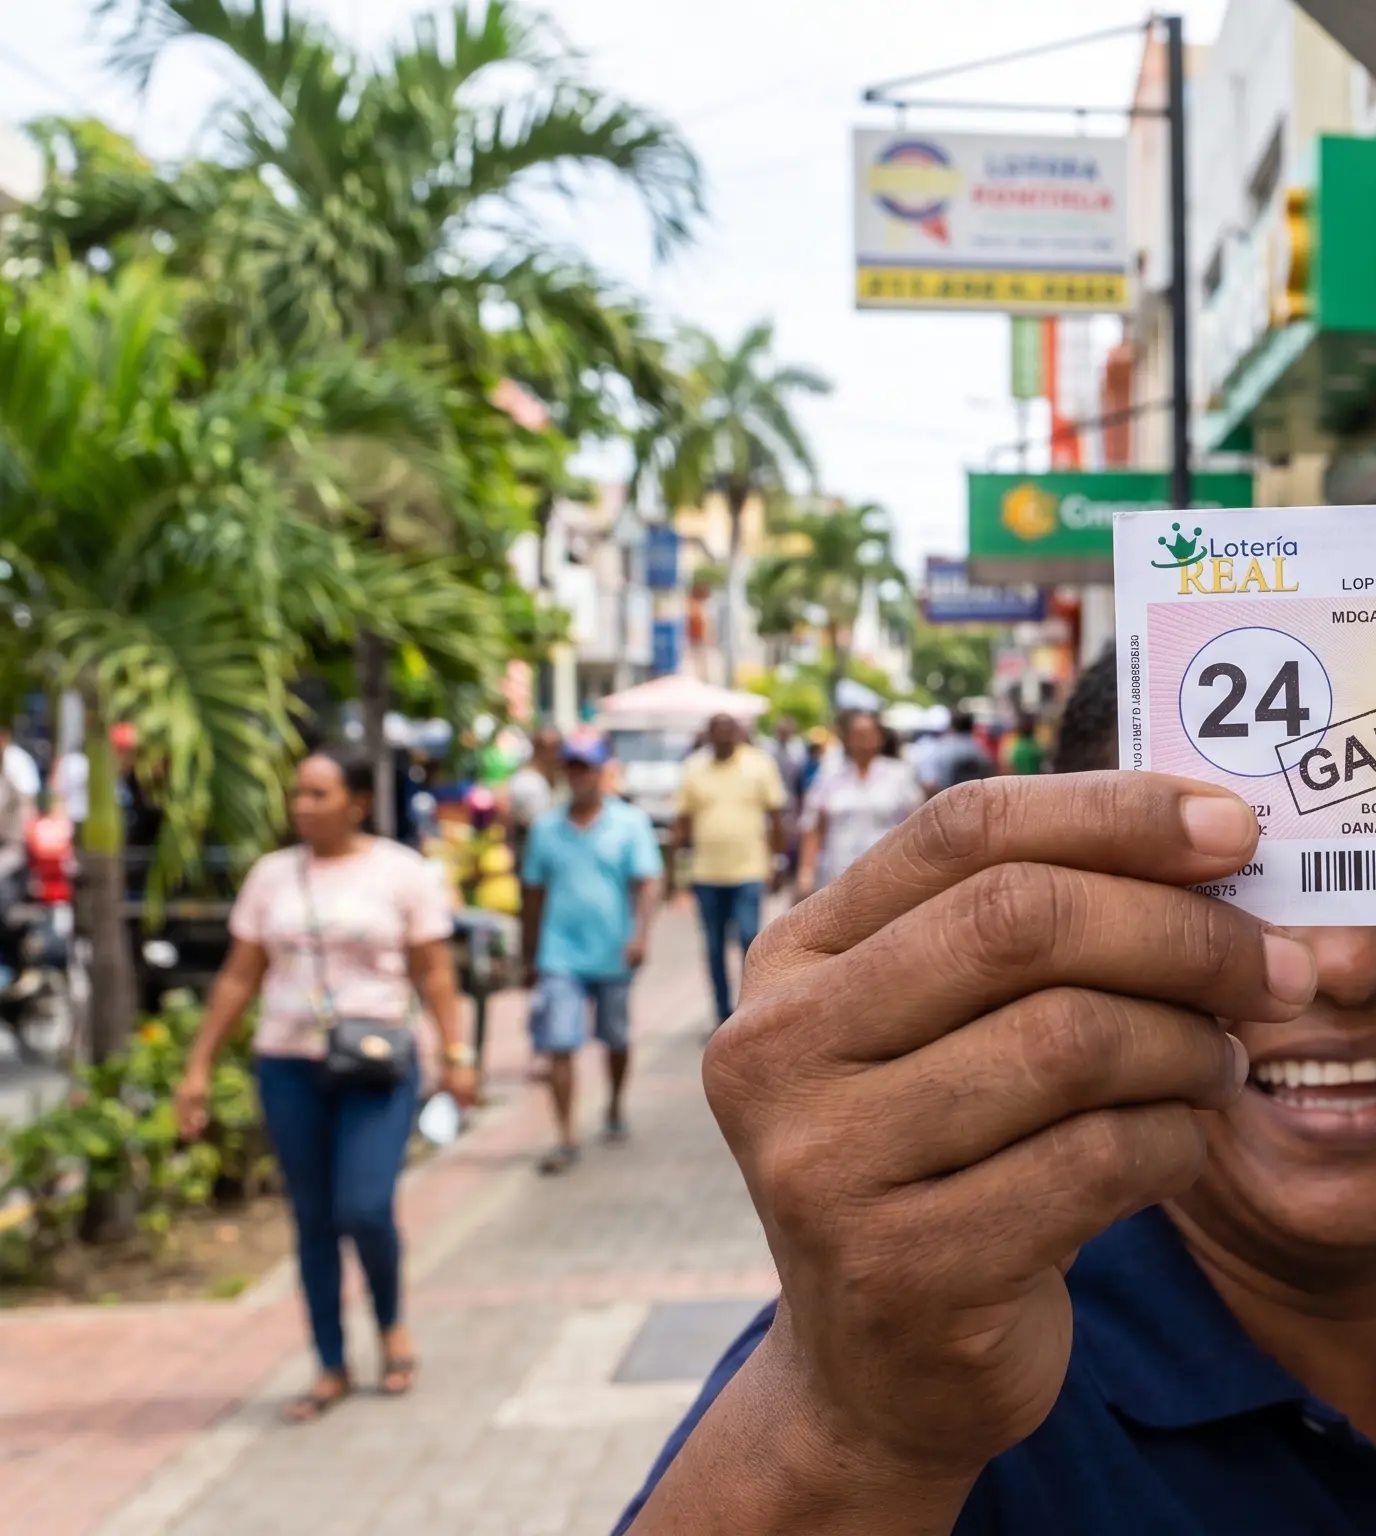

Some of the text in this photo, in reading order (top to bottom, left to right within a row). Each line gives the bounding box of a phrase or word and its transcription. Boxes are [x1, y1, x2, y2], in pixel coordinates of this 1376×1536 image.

[1210, 536, 1298, 557] Lotería
[1177, 557, 1299, 595] REAL
[1198, 660, 1310, 738] 24
